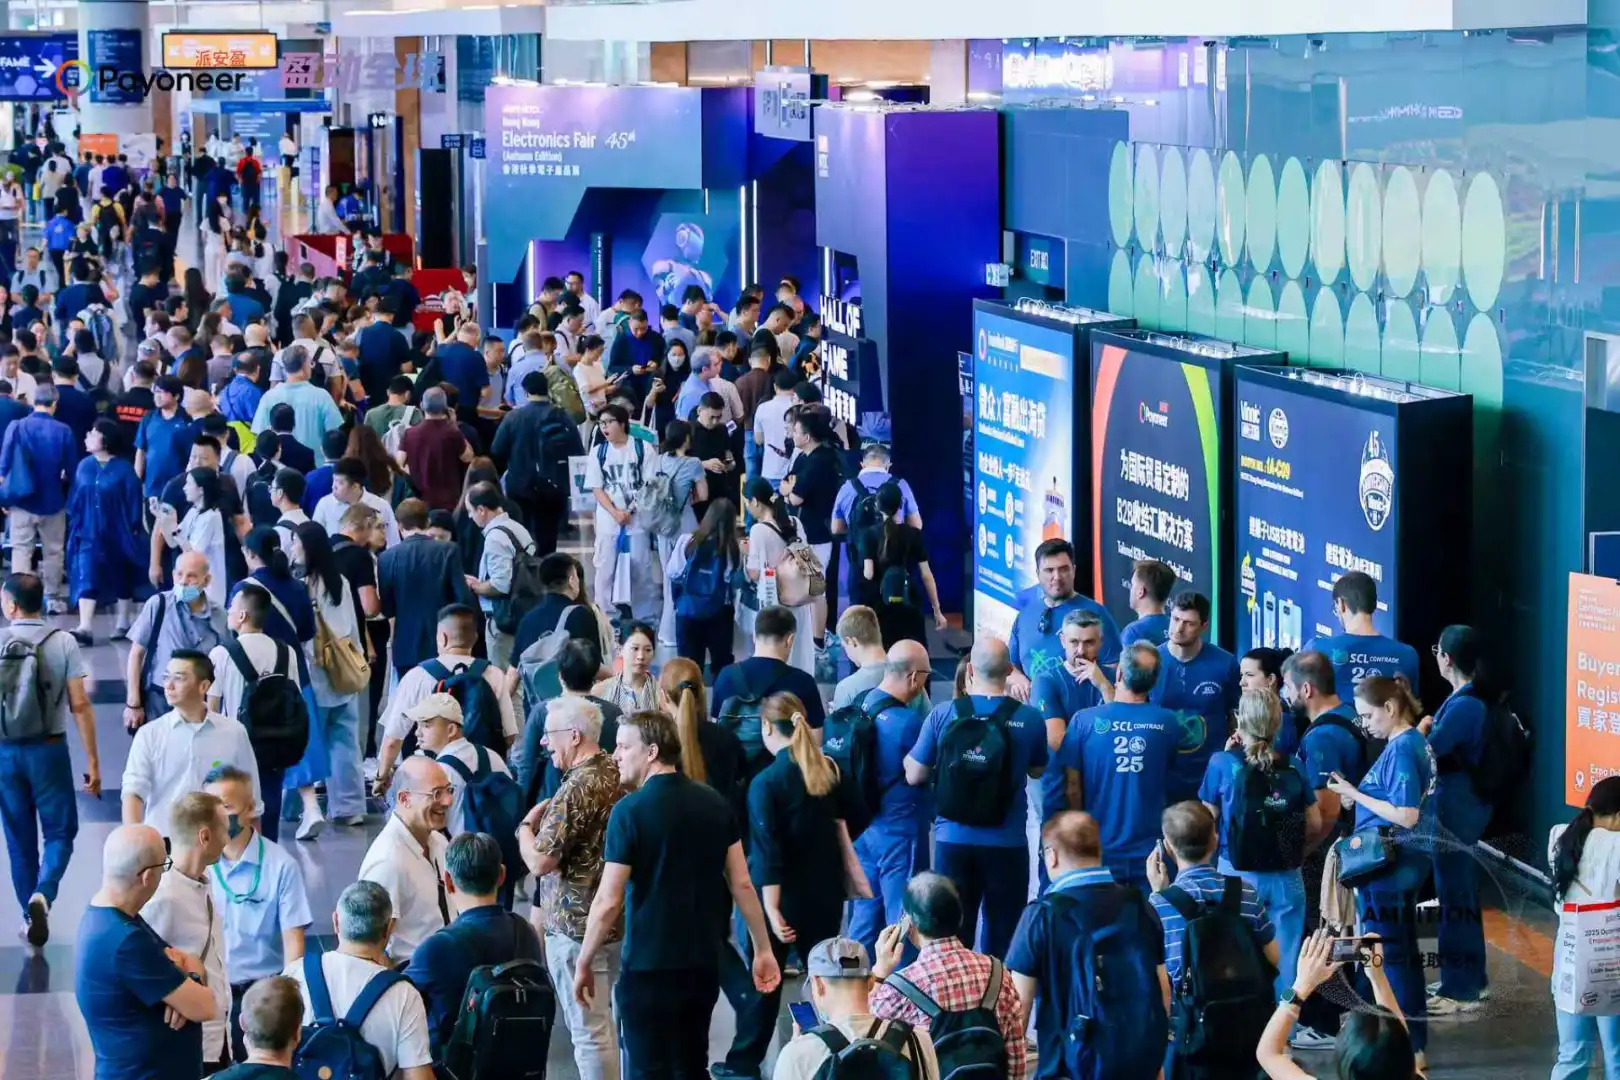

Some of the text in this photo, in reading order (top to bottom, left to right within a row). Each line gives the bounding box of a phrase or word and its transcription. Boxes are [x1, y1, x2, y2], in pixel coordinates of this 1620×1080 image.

[502, 130, 571, 148] Electronics
[573, 131, 597, 148] Fair
[820, 294, 860, 339] HALL OF
[821, 339, 848, 381] FAME
[1120, 448, 1189, 502] 为国际贸易定制的
[1349, 653, 1400, 664] SCL CONTRADE
[1111, 720, 1165, 732] SCL CONTRADE
[1115, 755, 1145, 773] 25
